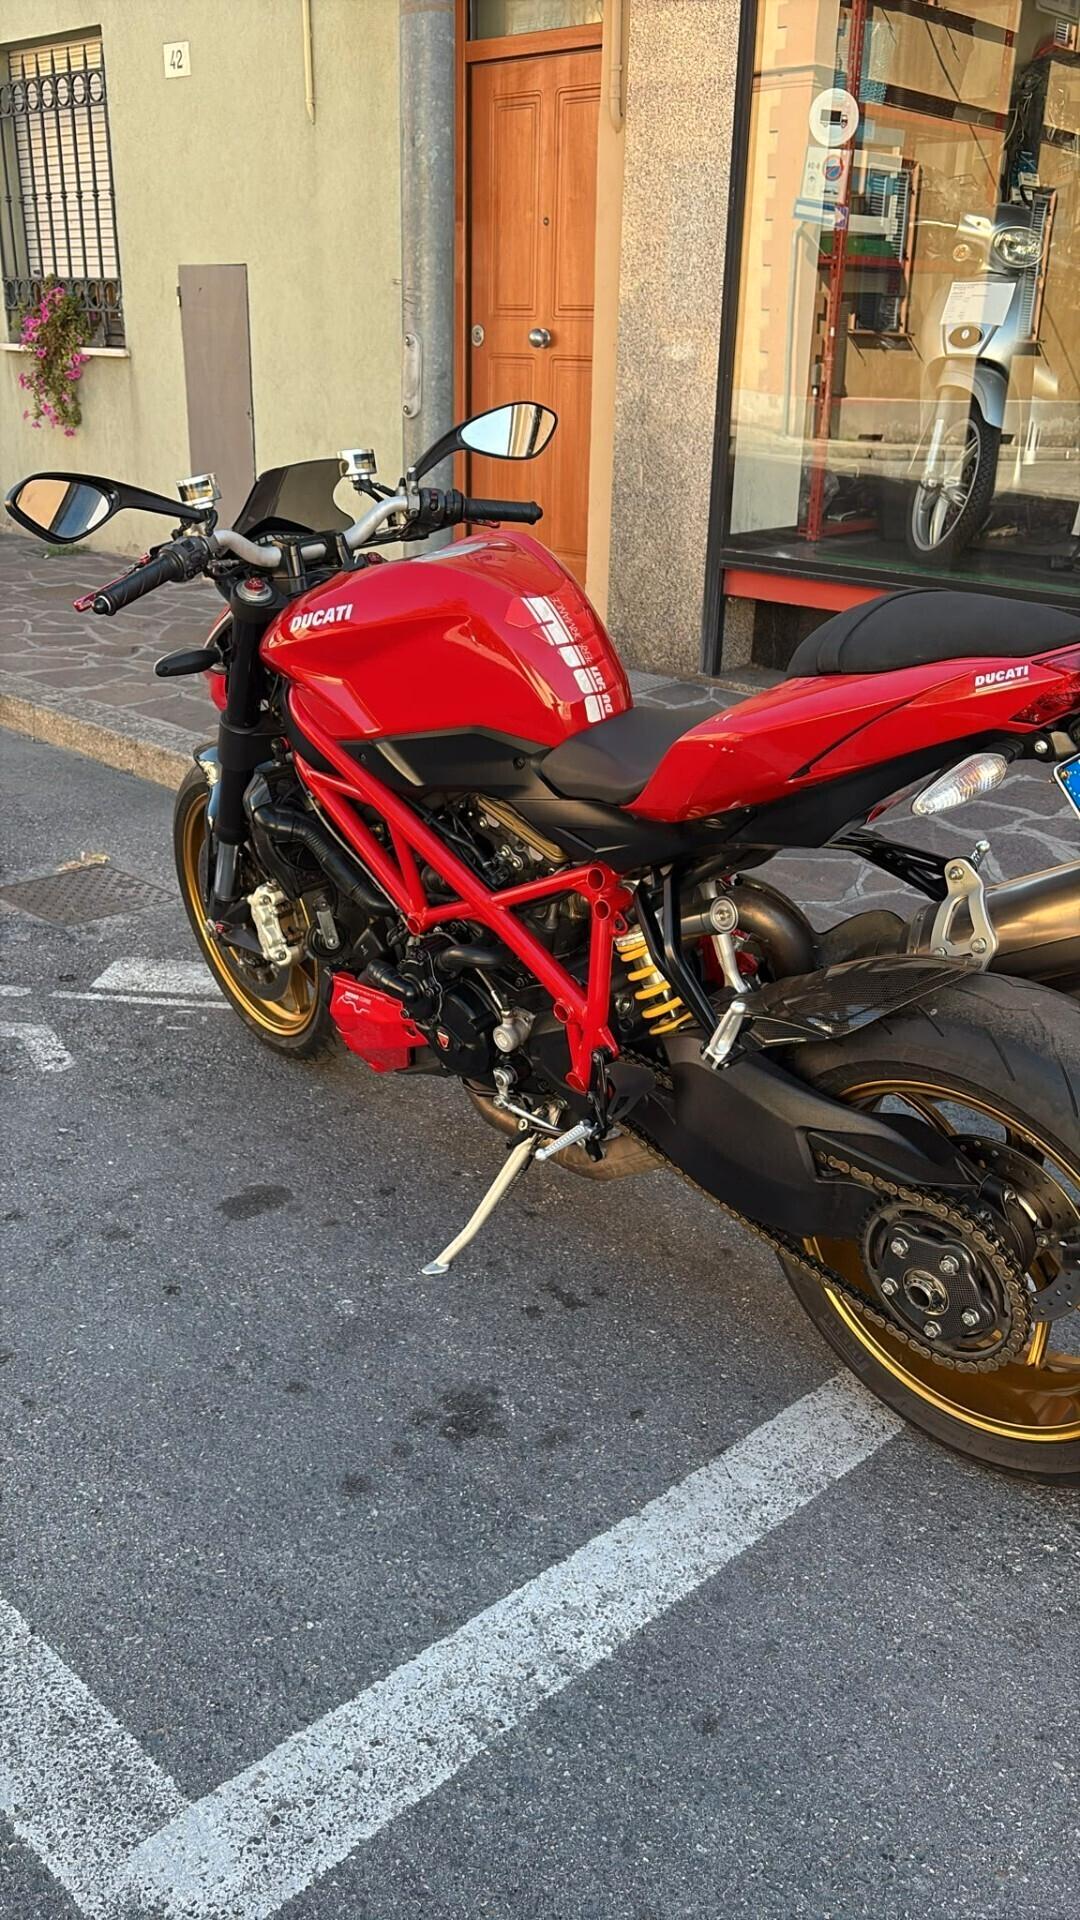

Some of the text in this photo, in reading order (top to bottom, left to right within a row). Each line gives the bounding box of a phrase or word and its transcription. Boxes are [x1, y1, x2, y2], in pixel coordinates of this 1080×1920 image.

[170, 49, 183, 70] 42
[290, 603, 353, 632] DUCATI
[975, 665, 1029, 687] DUCATI
